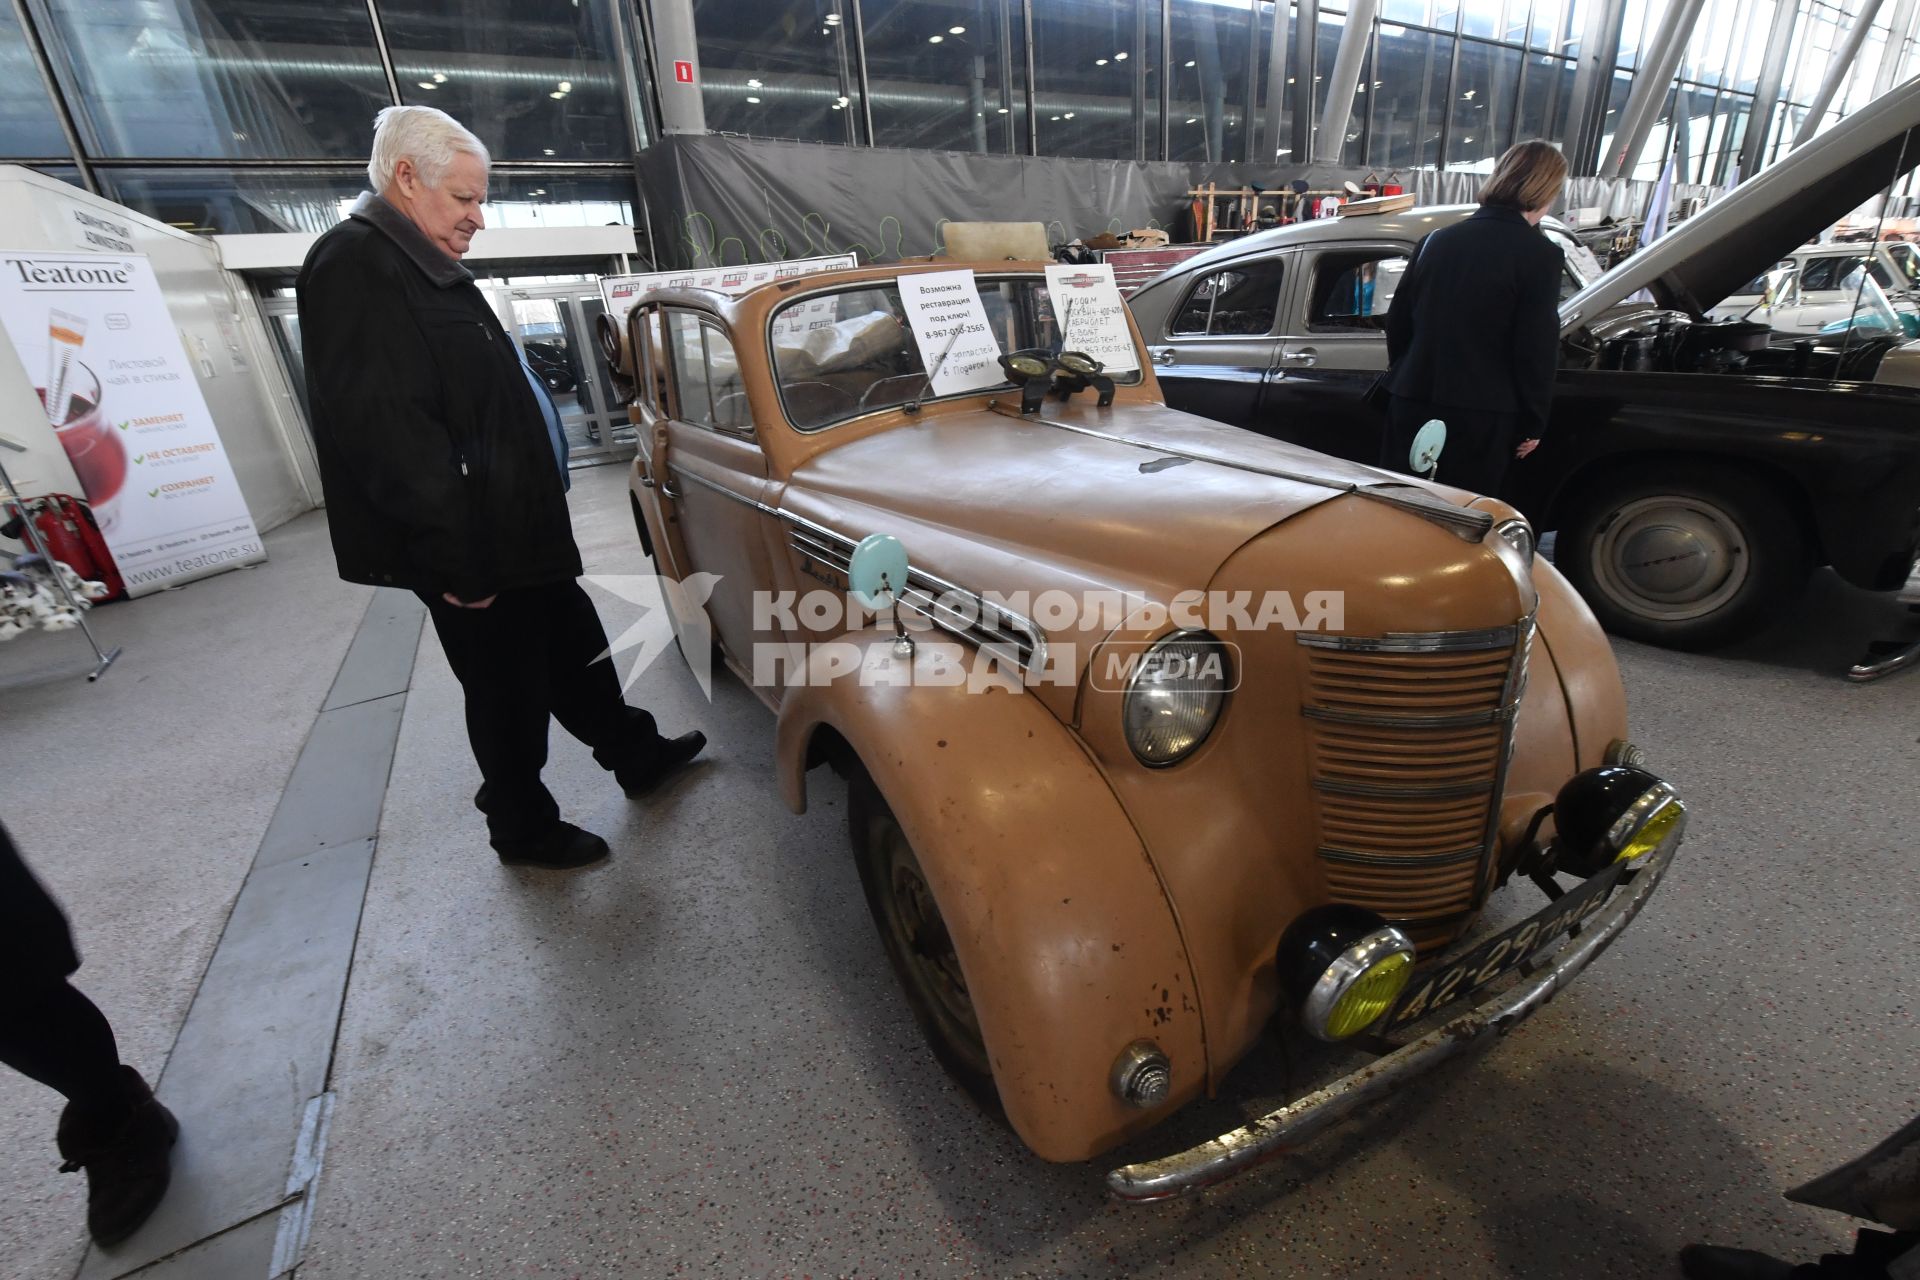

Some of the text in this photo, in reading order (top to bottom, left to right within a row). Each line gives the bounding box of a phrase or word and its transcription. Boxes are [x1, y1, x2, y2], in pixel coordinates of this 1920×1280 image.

[919, 284, 962, 295] Возможна
[920, 298, 970, 311] реставрация
[929, 310, 970, 323] под ключ!
[131, 413, 185, 427] ЗАМЕНЯЕТ
[147, 450, 161, 461] НЕ
[160, 475, 215, 492] СОХРАНЯЕТ
[127, 542, 260, 585] www.teatone.su
